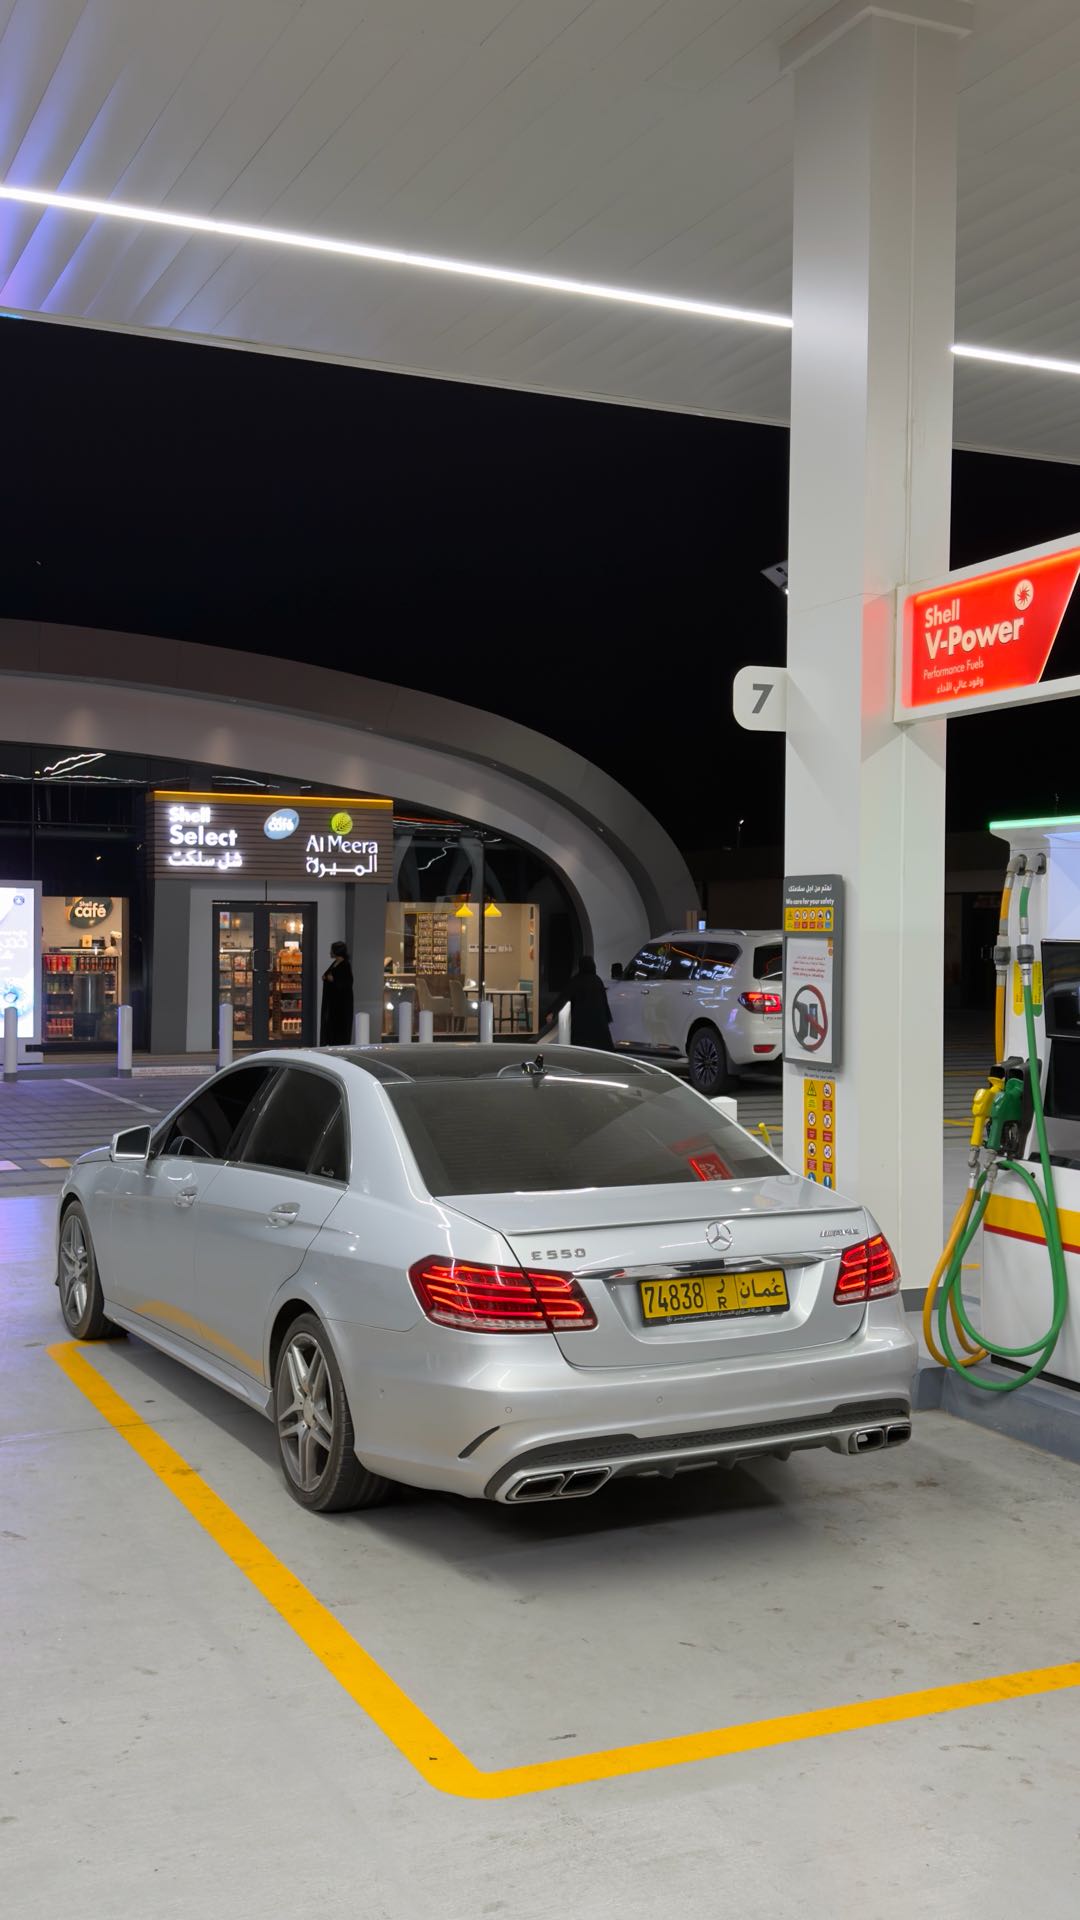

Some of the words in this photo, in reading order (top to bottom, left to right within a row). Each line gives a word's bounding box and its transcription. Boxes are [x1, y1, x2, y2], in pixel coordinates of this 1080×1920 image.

[925, 598, 961, 629] Shell
[925, 617, 1025, 660] V-Power
[923, 664, 966, 680] Performance
[966, 655, 984, 670] Fuels
[751, 683, 775, 714] 7
[169, 806, 212, 823] Shell
[169, 824, 238, 846] Select
[306, 834, 325, 853] Al
[327, 835, 379, 854] Meera
[168, 849, 216, 867] سلكت
[217, 851, 243, 871] شل
[306, 854, 378, 878] الميرة
[74, 902, 107, 918] café
[531, 1251, 543, 1261] E
[546, 1248, 586, 1260] 550
[644, 1282, 704, 1314] 74838
[718, 1296, 728, 1310] R
